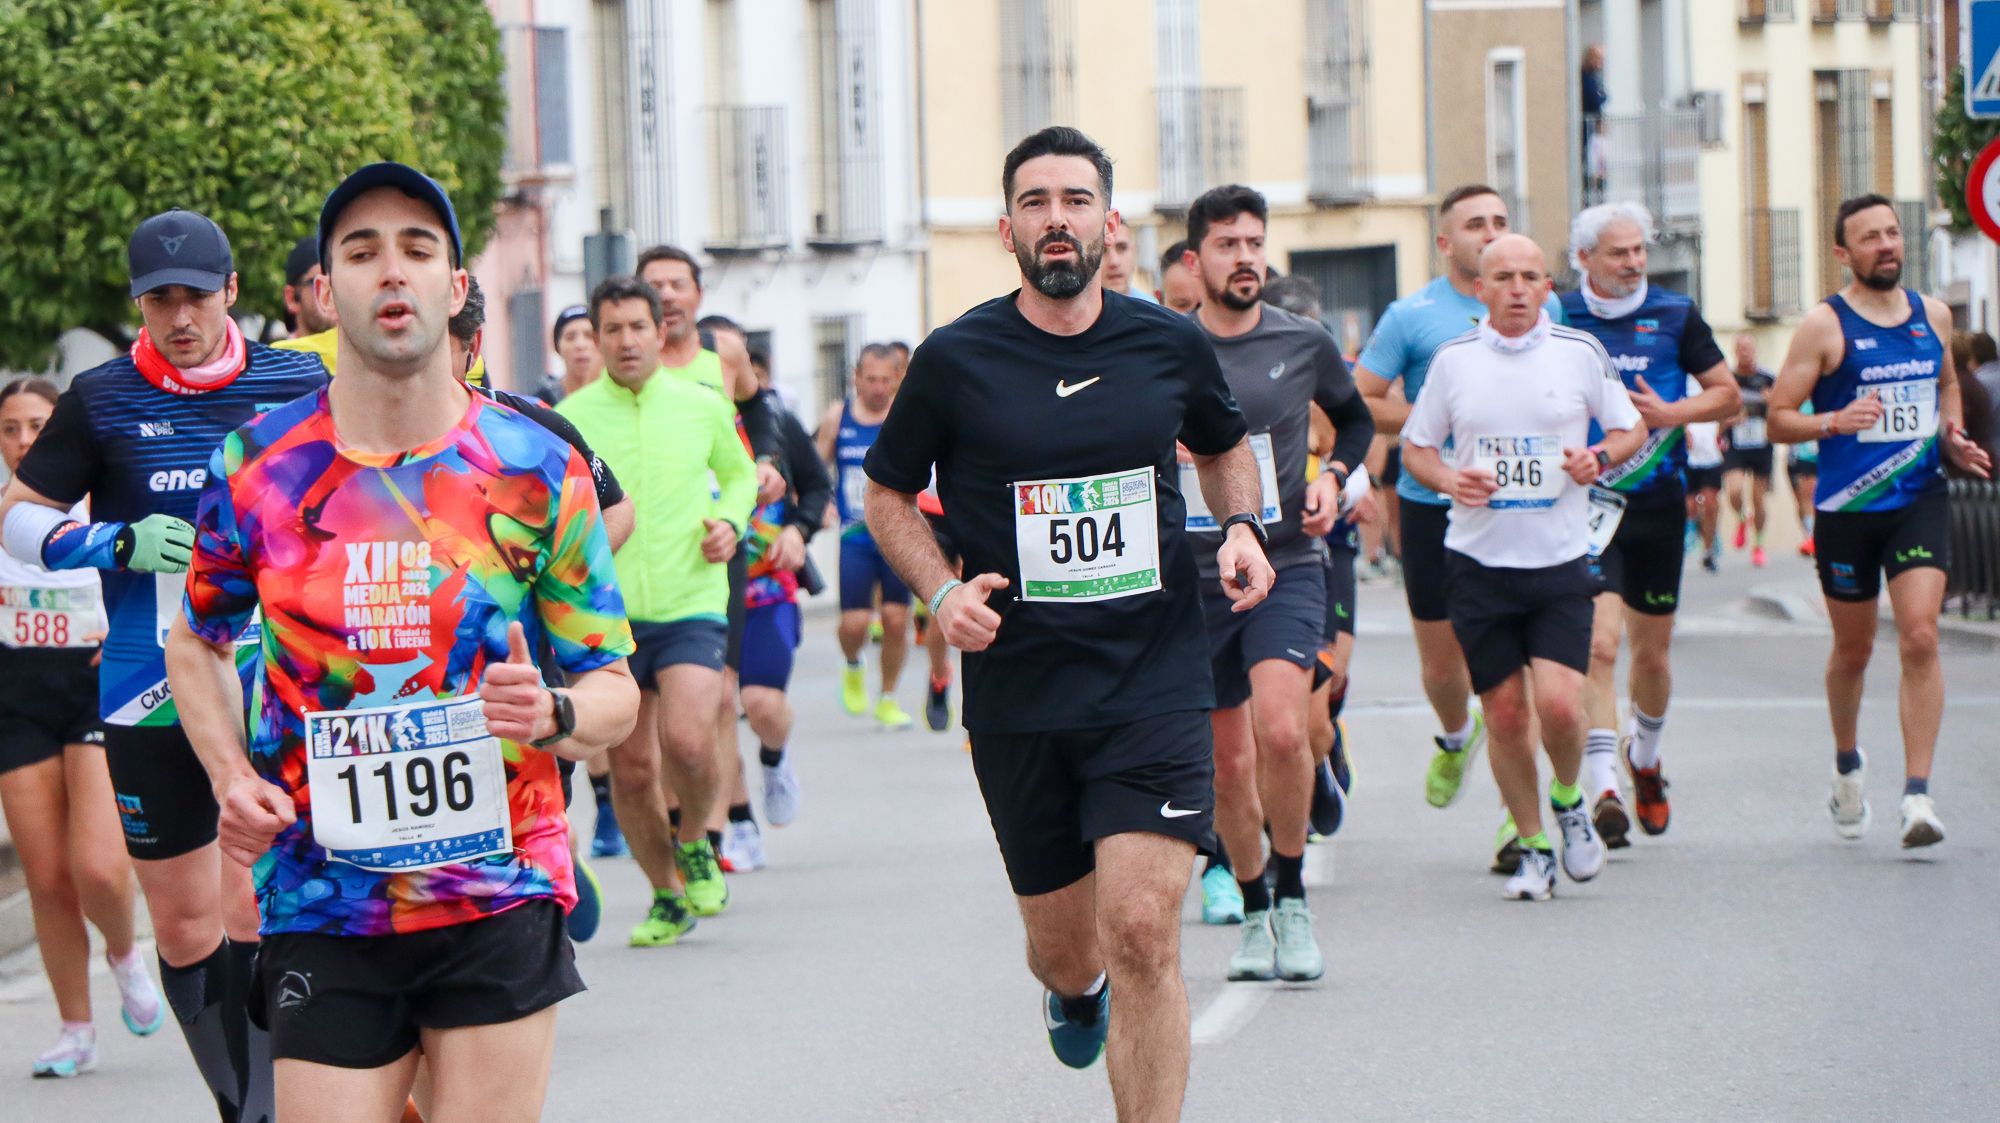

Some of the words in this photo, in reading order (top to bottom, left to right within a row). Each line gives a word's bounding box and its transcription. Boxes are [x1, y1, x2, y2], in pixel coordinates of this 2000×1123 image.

[157, 427, 174, 436] PRO
[1882, 405, 1919, 433] 163
[1496, 460, 1541, 487] 846
[1029, 484, 1073, 514] 10K
[1049, 512, 1125, 564] 504
[344, 541, 399, 584] XII
[401, 541, 432, 568] 08
[344, 584, 401, 606] MEDIA
[402, 581, 432, 597] 2026
[344, 600, 431, 628] MARATÓN
[15, 611, 69, 645] 588
[346, 635, 357, 651] &
[358, 628, 392, 650] 10K
[393, 628, 420, 638] Ciudad
[422, 626, 431, 636] de
[394, 636, 432, 649] LUCENA
[332, 714, 392, 757] 21K
[338, 751, 474, 824] 1196
